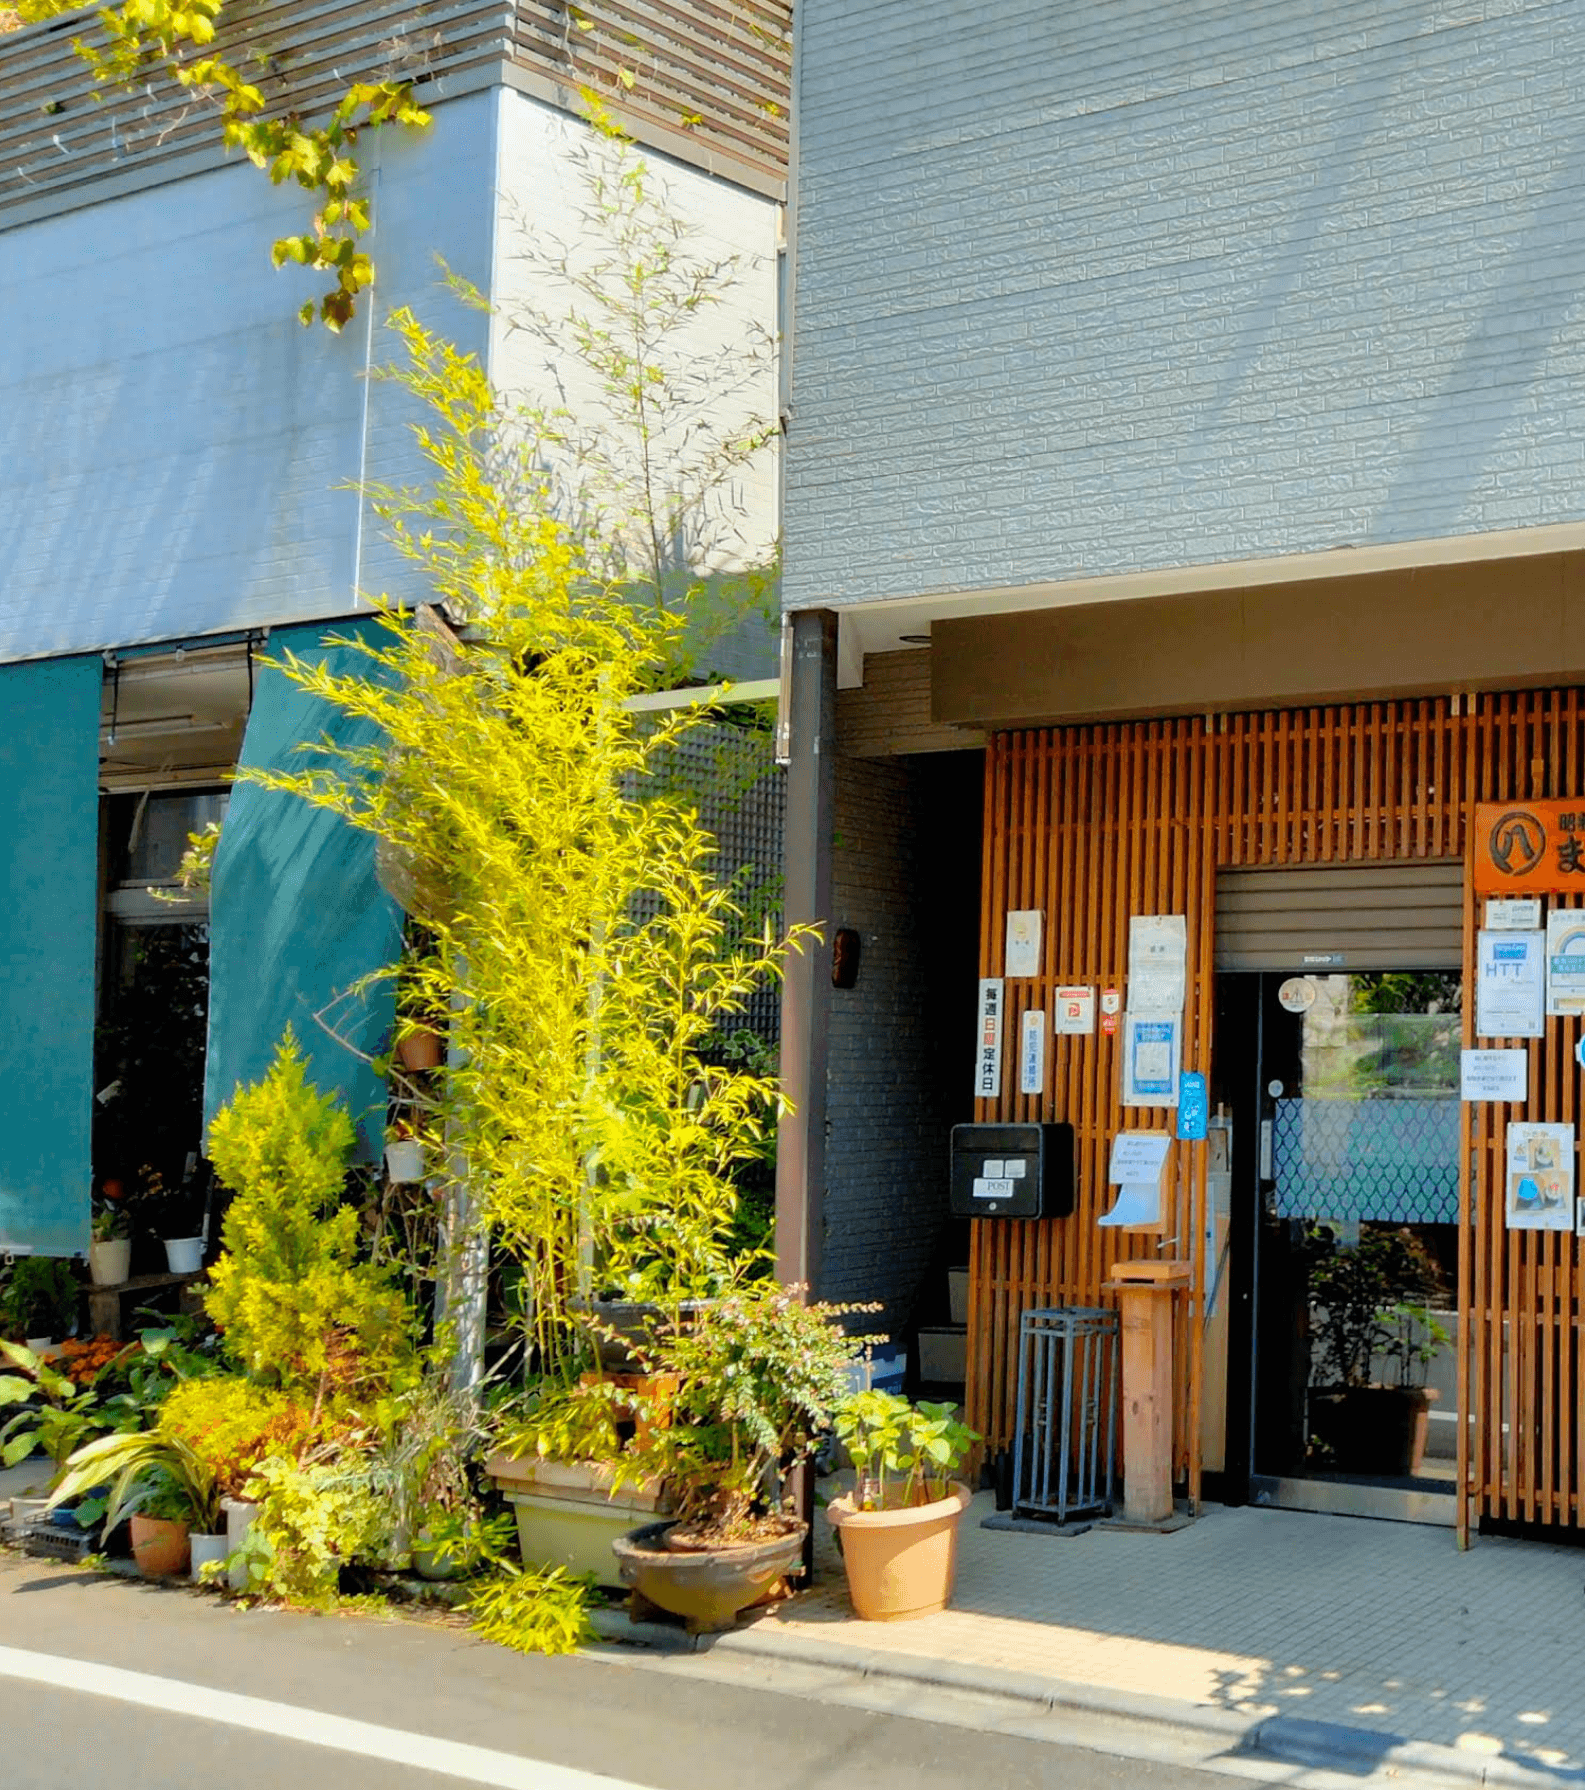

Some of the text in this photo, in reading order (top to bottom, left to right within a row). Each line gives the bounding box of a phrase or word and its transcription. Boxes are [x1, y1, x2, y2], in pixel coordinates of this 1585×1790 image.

[1485, 963, 1523, 977] HTT
[982, 987, 998, 1091] 毎週日曜定休日
[987, 1181, 1010, 1191] POST
